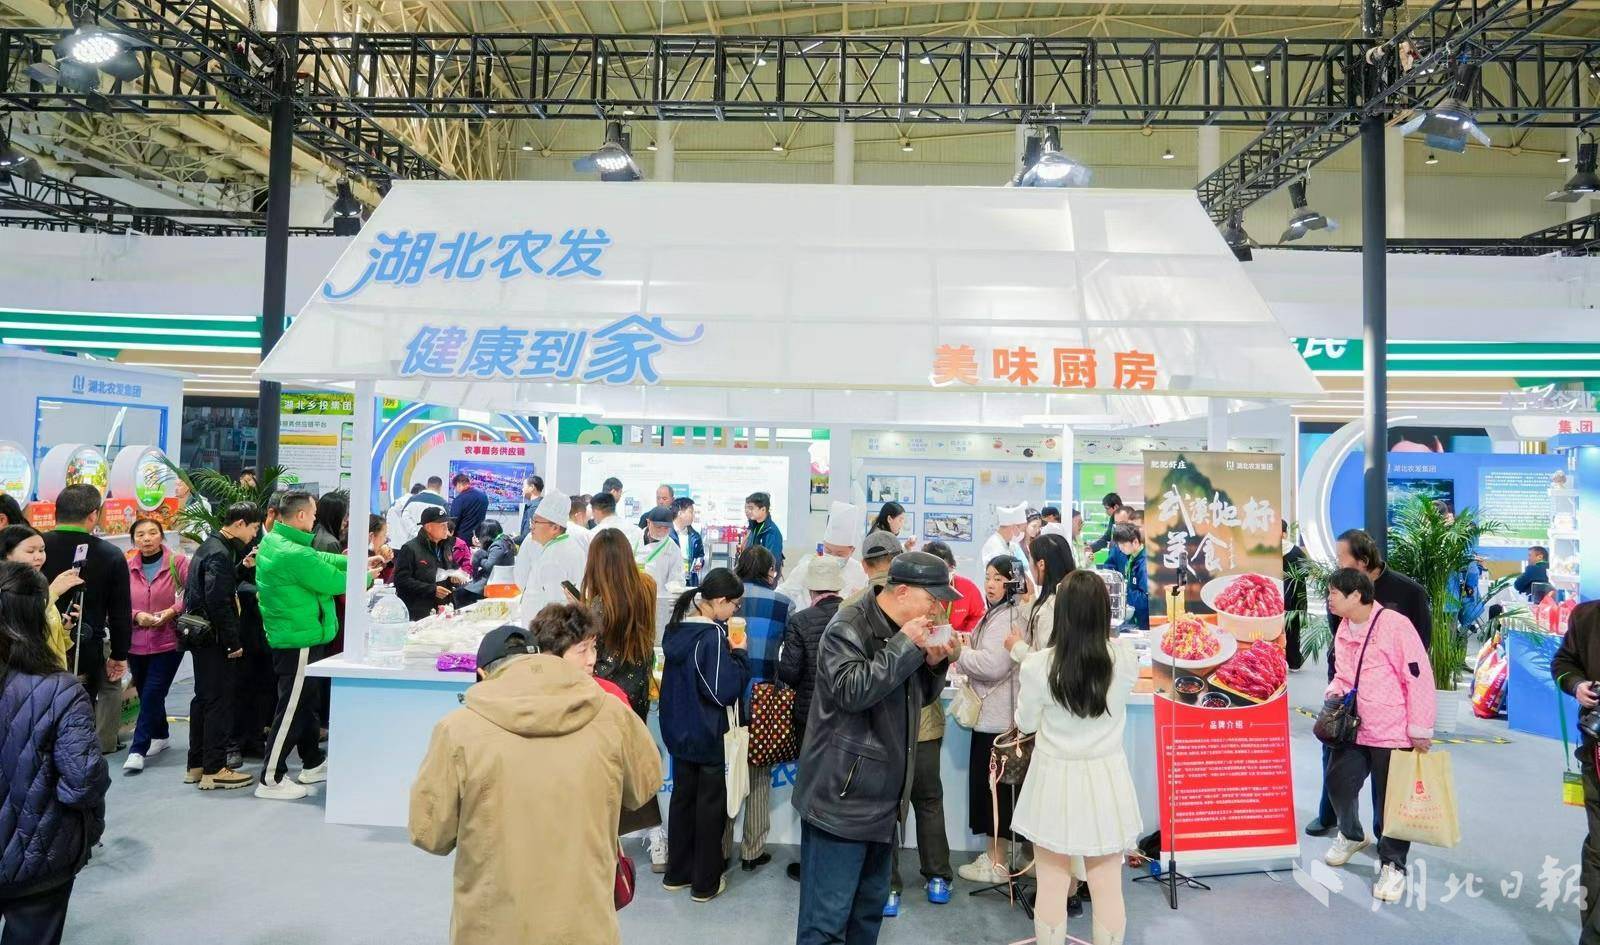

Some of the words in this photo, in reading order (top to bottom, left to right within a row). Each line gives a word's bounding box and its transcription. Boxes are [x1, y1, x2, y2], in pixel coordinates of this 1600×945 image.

[323, 229, 612, 300] 湖北农发
[401, 313, 704, 384] 健康到家
[932, 343, 1158, 390] 美味厨房
[284, 399, 352, 411] 湖北乡投集团
[464, 445, 526, 456] 农事服务供应链
[1209, 720, 1244, 730] 品牌介绍
